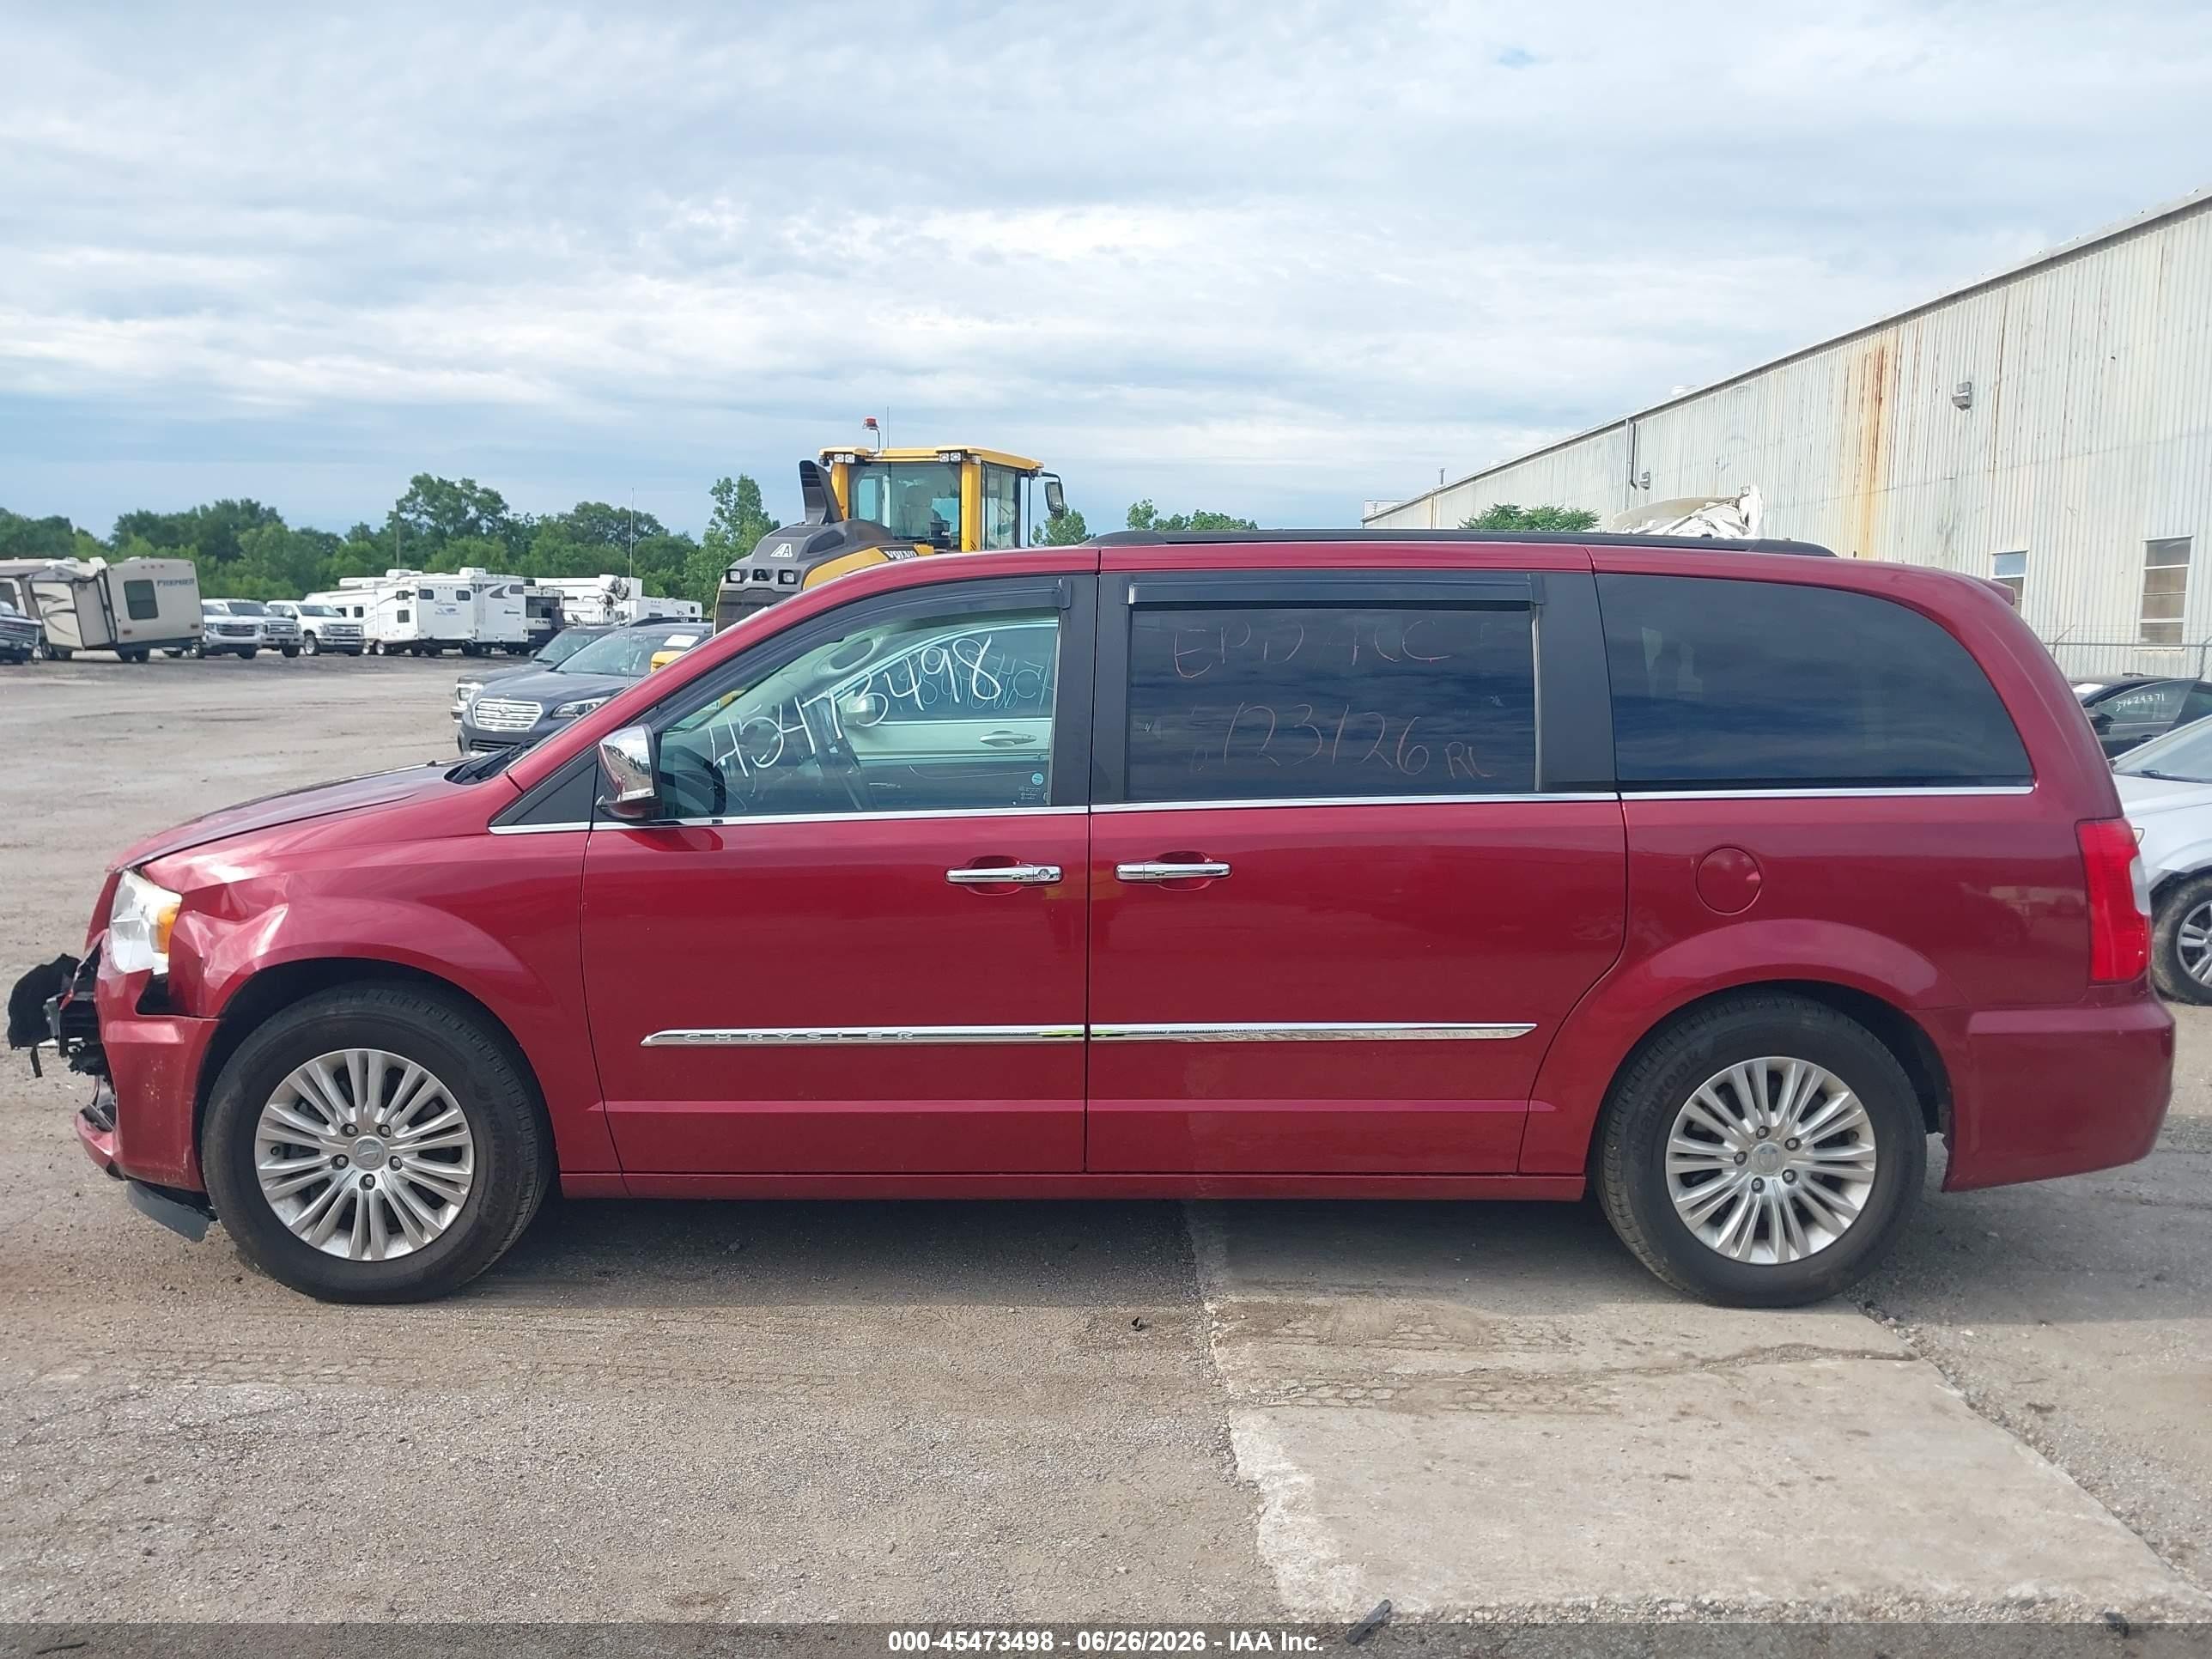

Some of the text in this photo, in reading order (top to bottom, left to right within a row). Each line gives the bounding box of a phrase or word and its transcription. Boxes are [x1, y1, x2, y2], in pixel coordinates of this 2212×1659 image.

[883, 550, 918, 560] VOLVO
[709, 634, 1001, 777] 45473498
[684, 1031, 915, 1042] CHRYSLER
